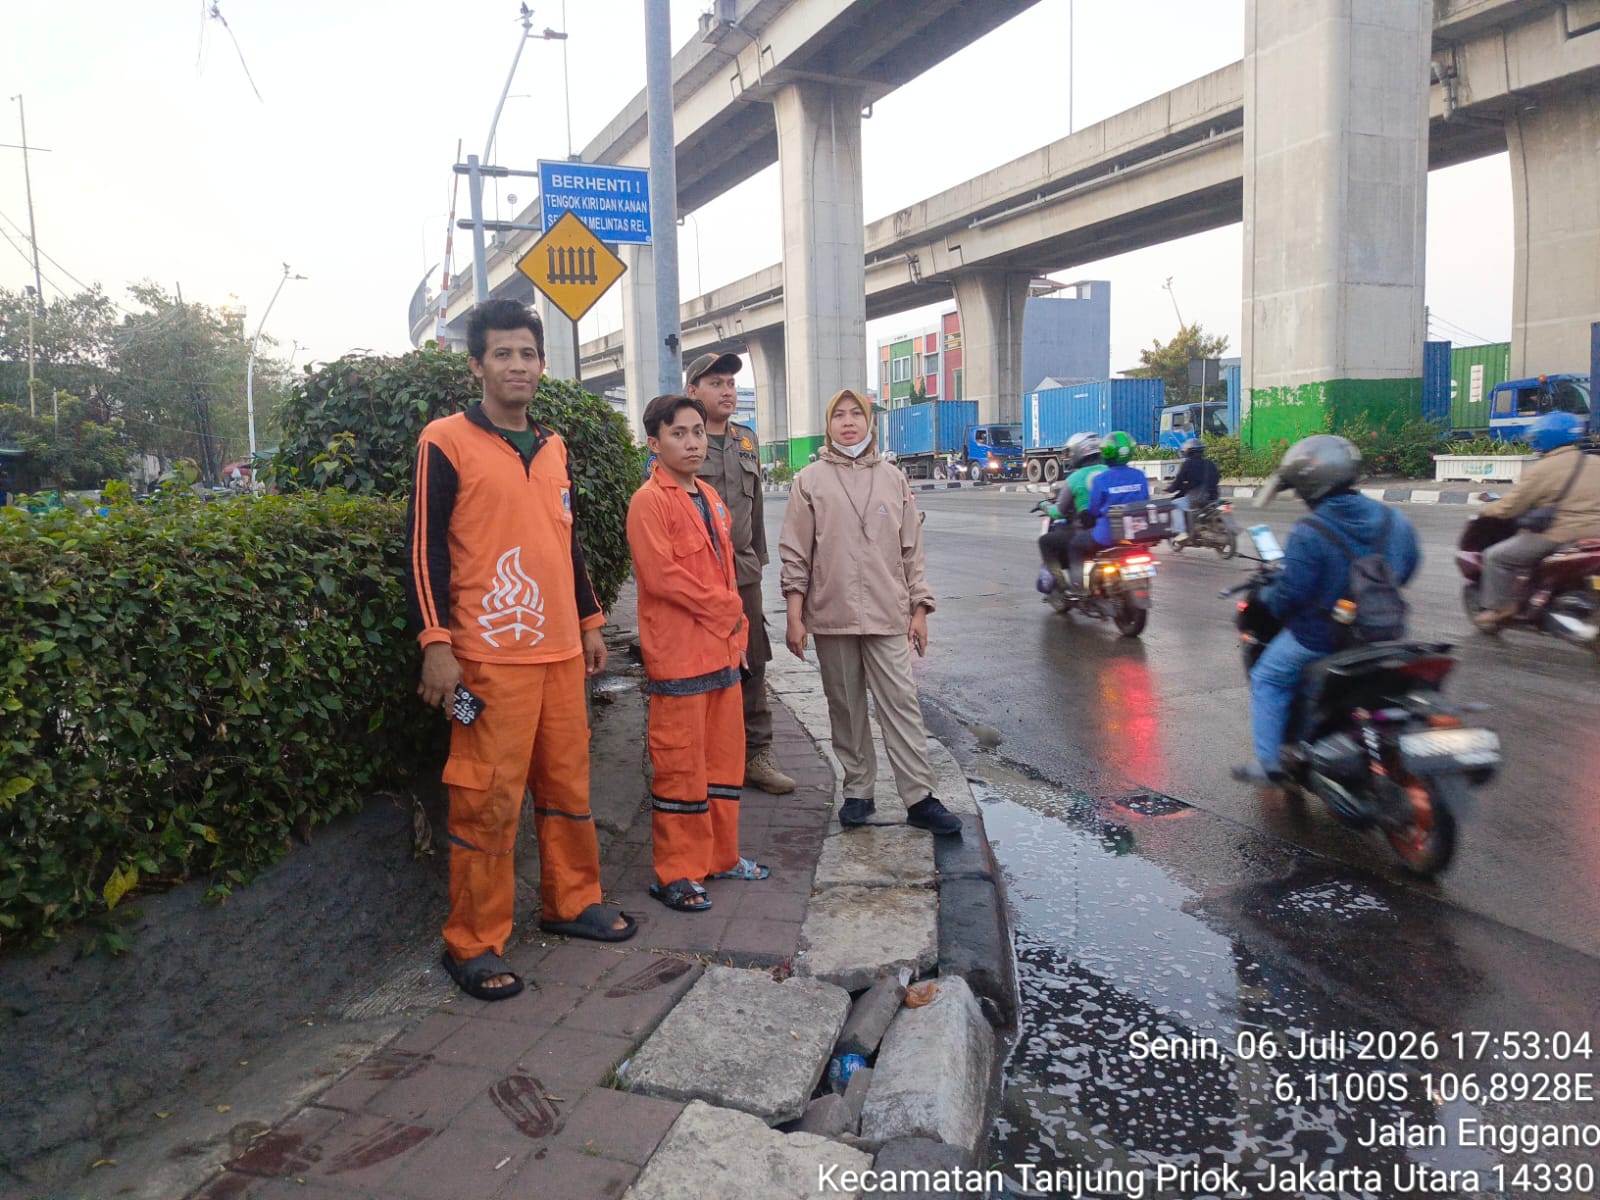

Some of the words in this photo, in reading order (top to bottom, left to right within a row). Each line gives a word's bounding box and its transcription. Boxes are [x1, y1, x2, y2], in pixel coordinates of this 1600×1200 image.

[551, 174, 631, 193] BERHENTI
[545, 194, 580, 209] TENGOK
[582, 197, 599, 210] KIRI
[599, 199, 619, 211] DAN
[619, 199, 648, 214] KANAN
[588, 216, 629, 232] MELINTAS
[631, 219, 648, 233] REL
